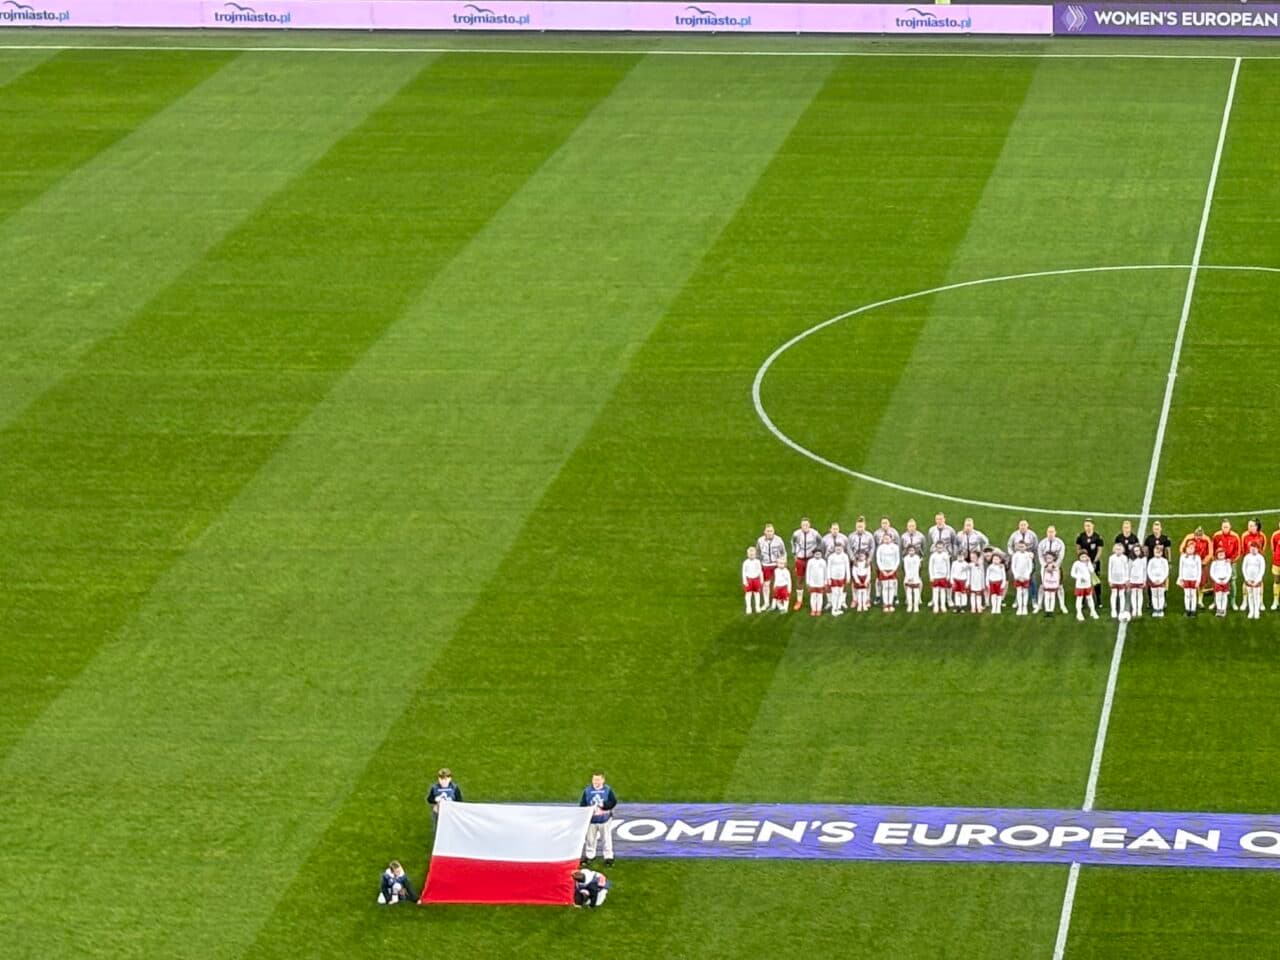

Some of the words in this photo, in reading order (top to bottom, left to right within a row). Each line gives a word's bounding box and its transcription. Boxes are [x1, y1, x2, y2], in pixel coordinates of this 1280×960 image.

[215, 12, 291, 23] trojmiasto.pl
[453, 14, 530, 25] trojmiasto.pl
[675, 15, 752, 26] trojmiasto.pl
[896, 17, 971, 28] trojmiasto.pl
[1094, 10, 1177, 26] WOMEN'S
[1182, 12, 1278, 27] EUROPEAN
[606, 818, 855, 844] OMEN'S
[872, 822, 1221, 852] EUROPEAN
